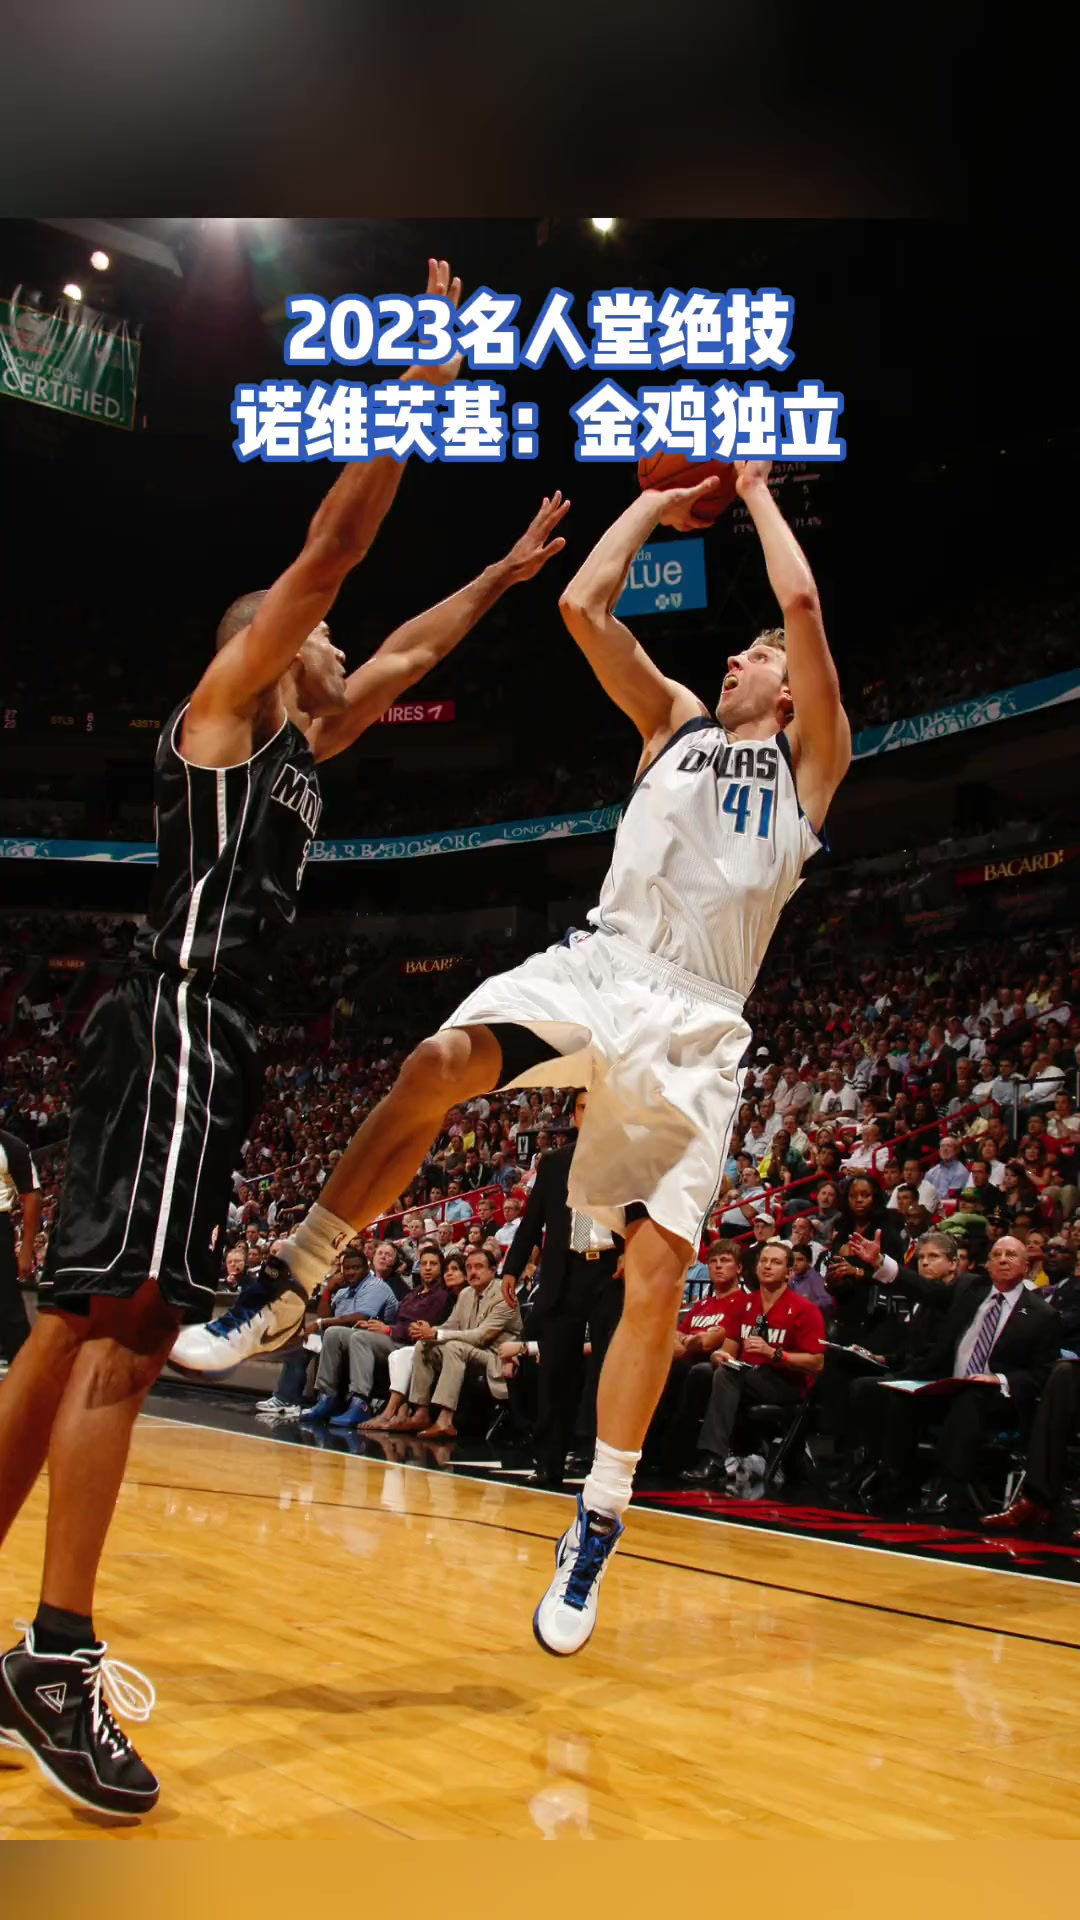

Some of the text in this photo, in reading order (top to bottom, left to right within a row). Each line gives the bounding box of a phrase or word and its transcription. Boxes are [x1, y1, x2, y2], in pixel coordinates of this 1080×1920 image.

[722, 783, 774, 840] 41
[503, 824, 545, 840] LONG
[740, 1323, 787, 1345] MMI
